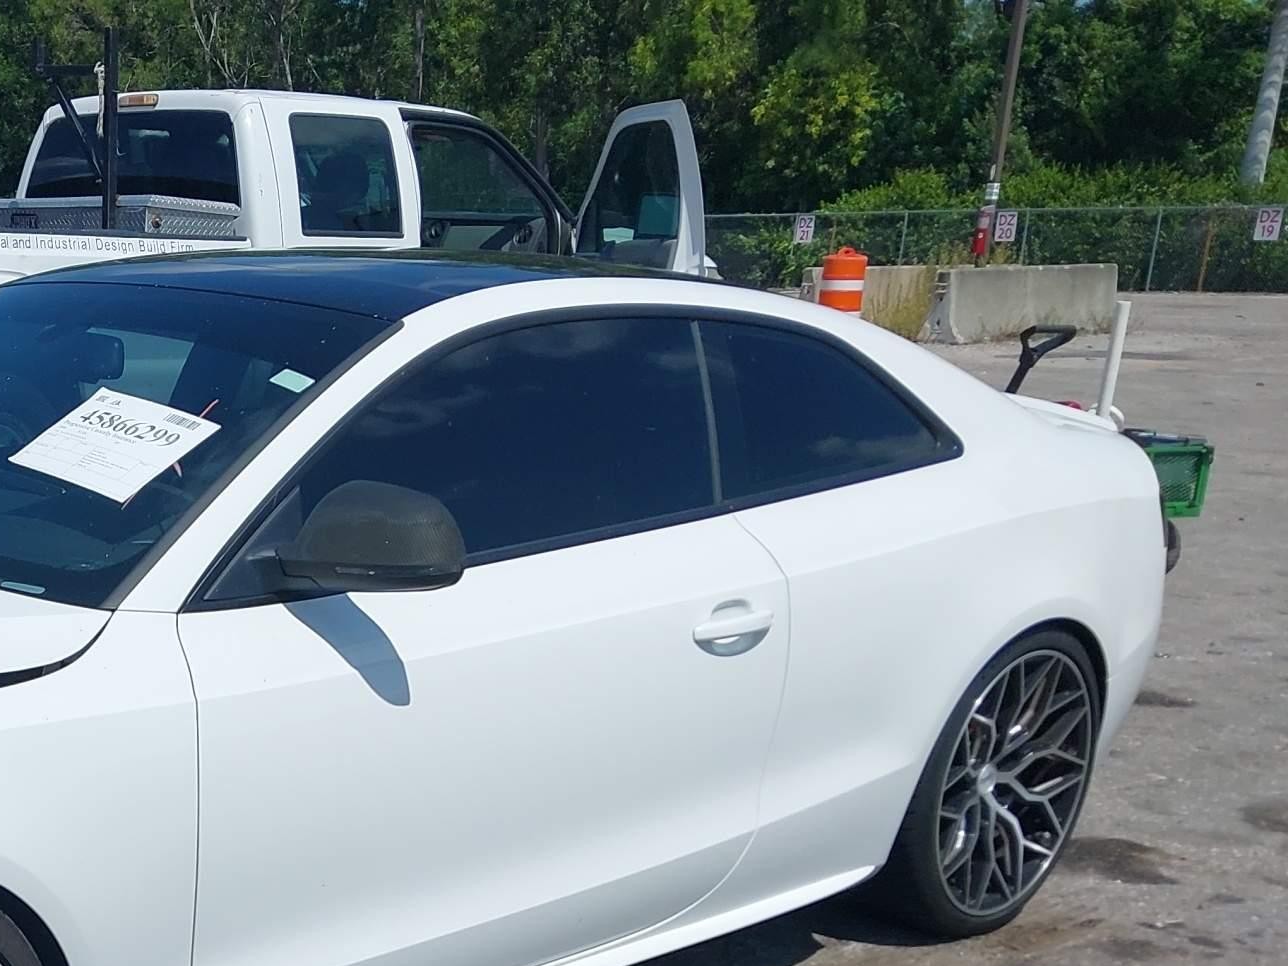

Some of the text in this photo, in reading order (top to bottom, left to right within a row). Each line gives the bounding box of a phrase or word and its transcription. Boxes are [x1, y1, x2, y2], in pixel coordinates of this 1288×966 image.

[799, 217, 814, 228] DZ
[999, 214, 1016, 226] DZ
[1259, 210, 1280, 223] DZ
[799, 230, 809, 240] 21
[998, 227, 1012, 239] 20
[1261, 224, 1274, 238] 19
[12, 237, 31, 249] and
[35, 237, 91, 250] Industrial
[95, 238, 134, 254] Design
[139, 240, 165, 253] Build
[170, 241, 194, 252] Firm
[80, 409, 181, 447] 45866299
